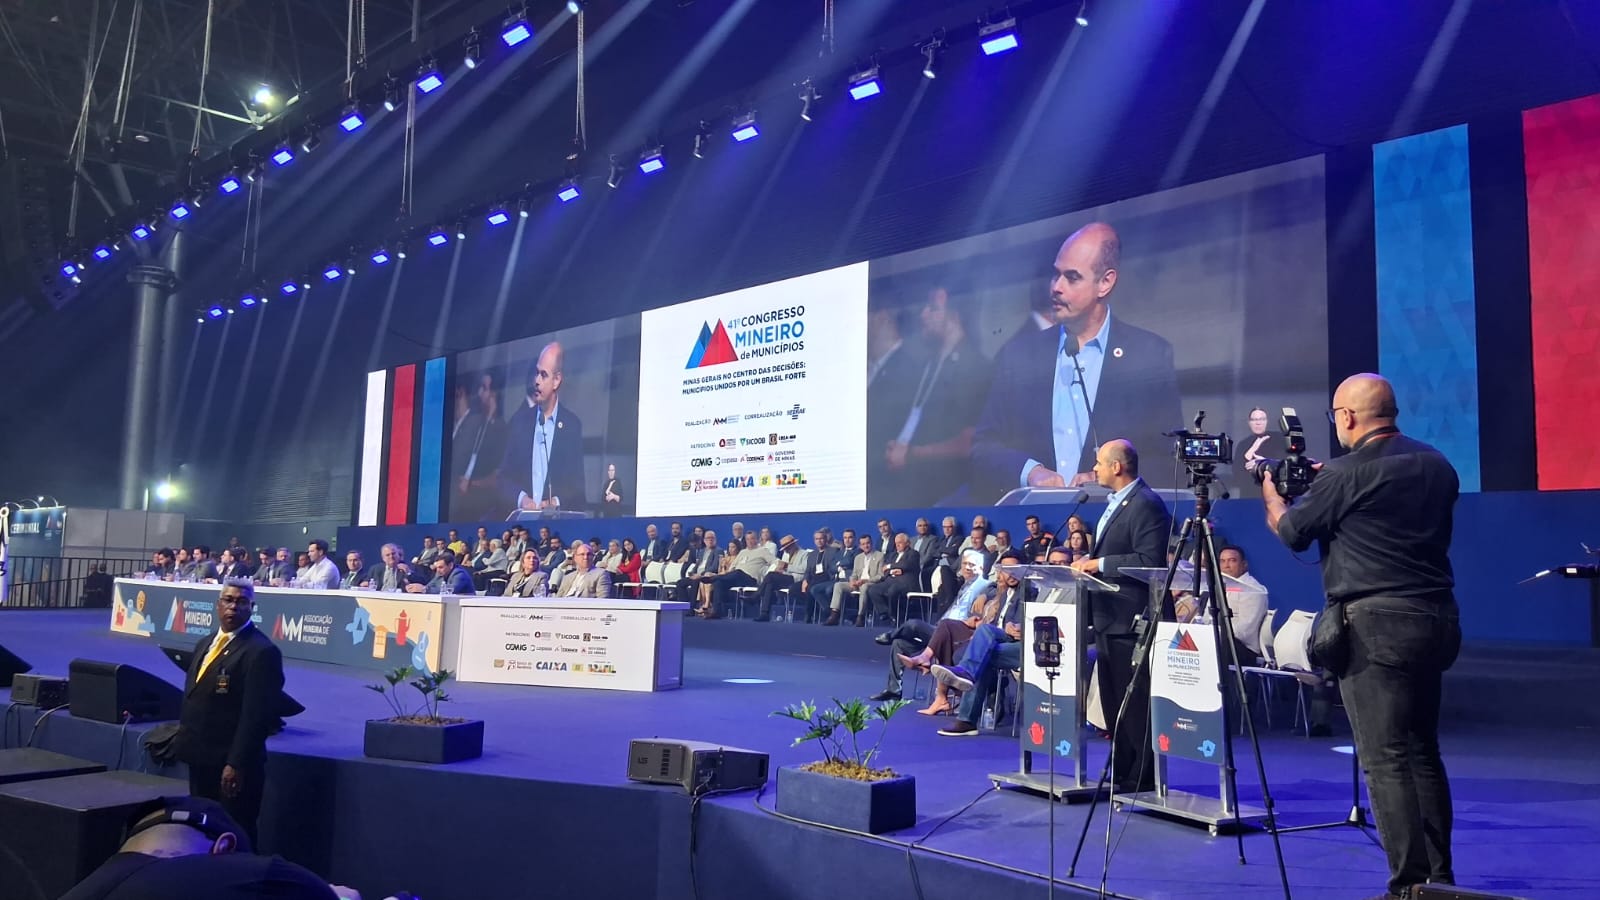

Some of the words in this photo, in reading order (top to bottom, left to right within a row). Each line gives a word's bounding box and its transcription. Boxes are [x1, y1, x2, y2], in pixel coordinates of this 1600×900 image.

[741, 305, 805, 327] CONGRESSO
[735, 320, 805, 348] MINEIRO
[740, 351, 751, 360] de
[751, 340, 805, 358] MUNICÍPIOS
[683, 376, 700, 386] MINAS
[701, 374, 721, 383] GERAIS
[732, 369, 757, 379] CENTRO
[758, 366, 771, 375] DAS
[772, 361, 806, 373] DECISÕES:
[714, 381, 737, 391] UNIDOS
[737, 379, 750, 388] POR
[751, 378, 760, 386] UM
[761, 374, 783, 384] BRASIL
[784, 371, 806, 380] FORTE
[721, 475, 755, 489] CAIXA
[184, 610, 213, 627] MINEIRO
[304, 614, 333, 625] ASSOCIAÇÃO
[303, 624, 322, 634] MINEIRA
[322, 626, 331, 635] DE
[535, 661, 568, 672] CAIXA
[1167, 655, 1200, 666] MINEIRO
